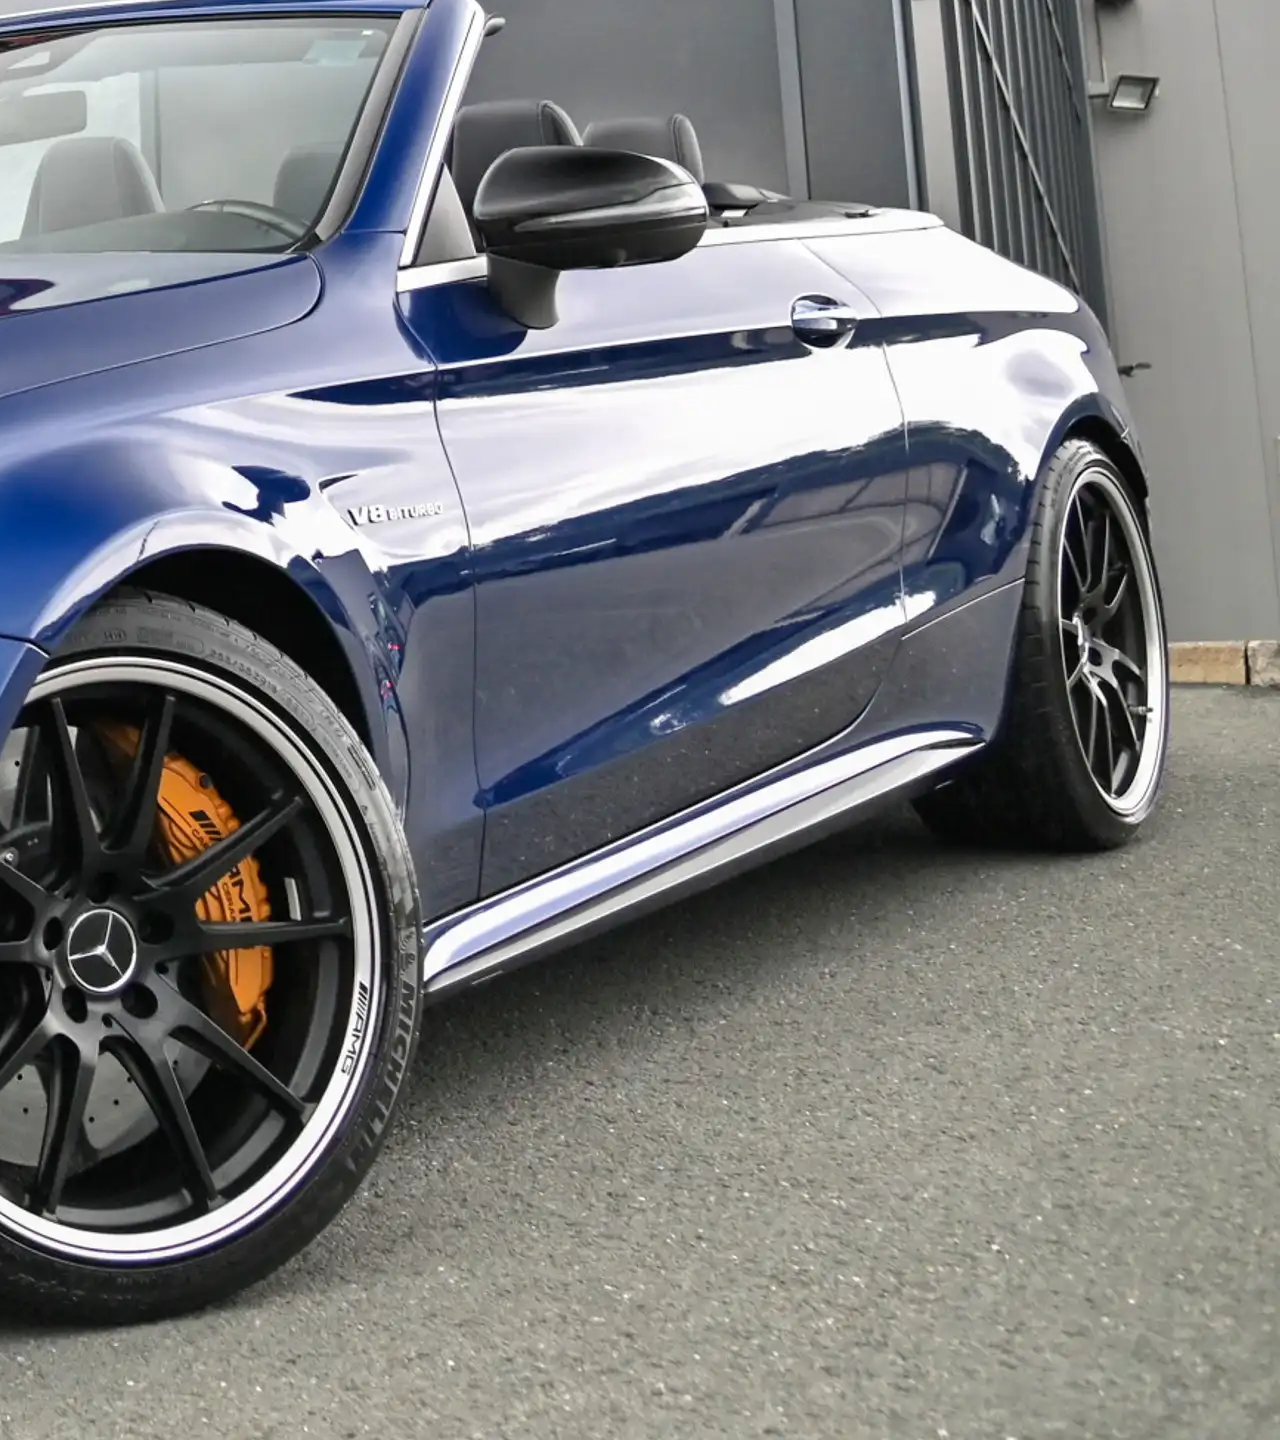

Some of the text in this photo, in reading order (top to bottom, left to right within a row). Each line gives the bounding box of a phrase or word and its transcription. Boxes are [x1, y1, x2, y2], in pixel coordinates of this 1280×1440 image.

[347, 502, 443, 526] V8 BITURBO
[340, 1009, 369, 1078] AMG
